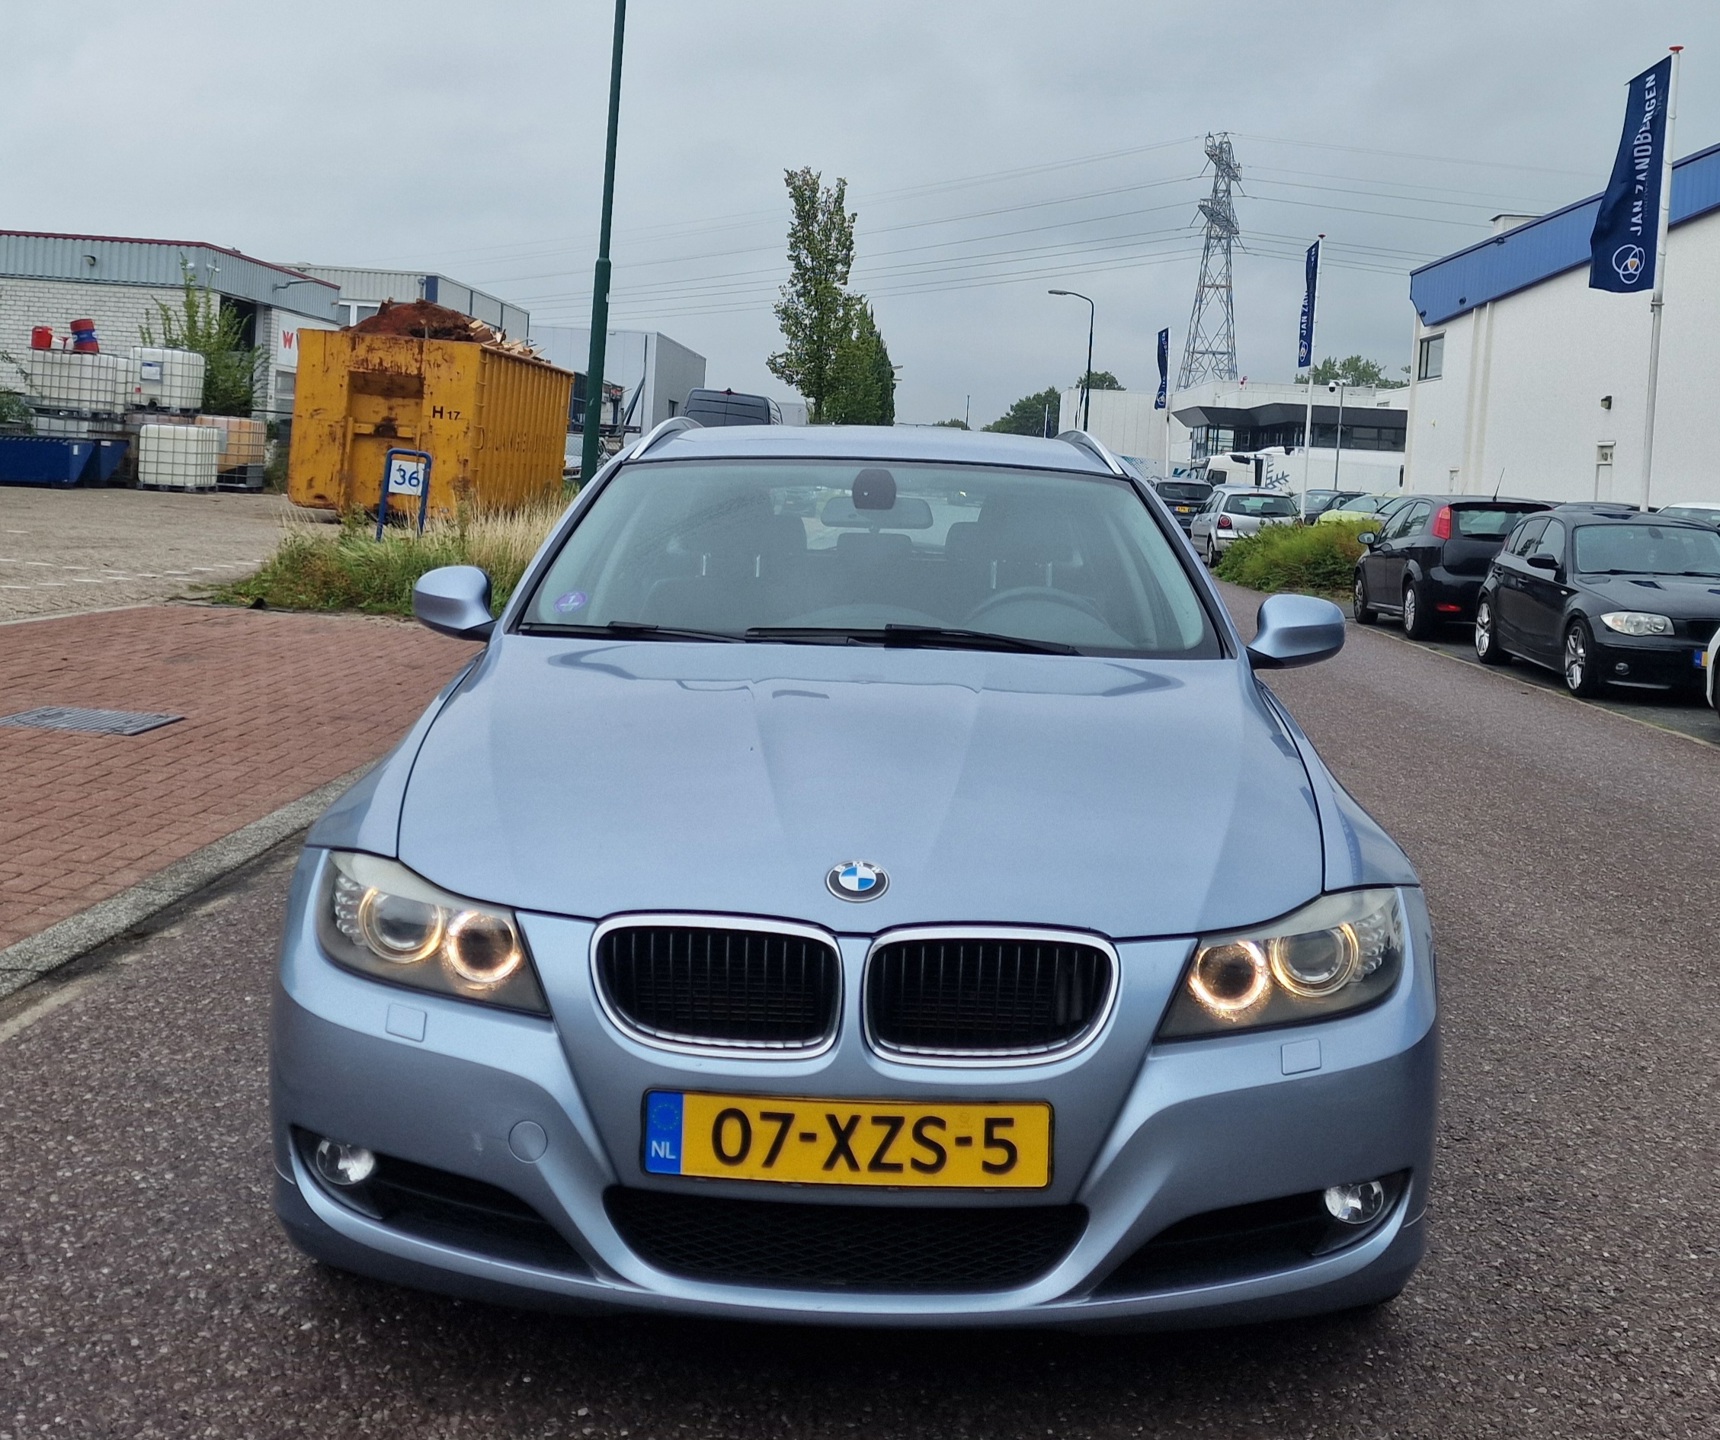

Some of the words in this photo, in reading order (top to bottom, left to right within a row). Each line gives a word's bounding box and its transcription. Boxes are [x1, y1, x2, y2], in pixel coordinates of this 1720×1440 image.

[1633, 73, 1657, 195] ZANDBERGEN
[1629, 203, 1643, 236] JAN
[432, 405, 443, 419] H
[447, 411, 460, 420] 17
[394, 468, 420, 487] 36
[651, 1140, 676, 1160] NL
[710, 1107, 1018, 1174] 07-XZS-5
